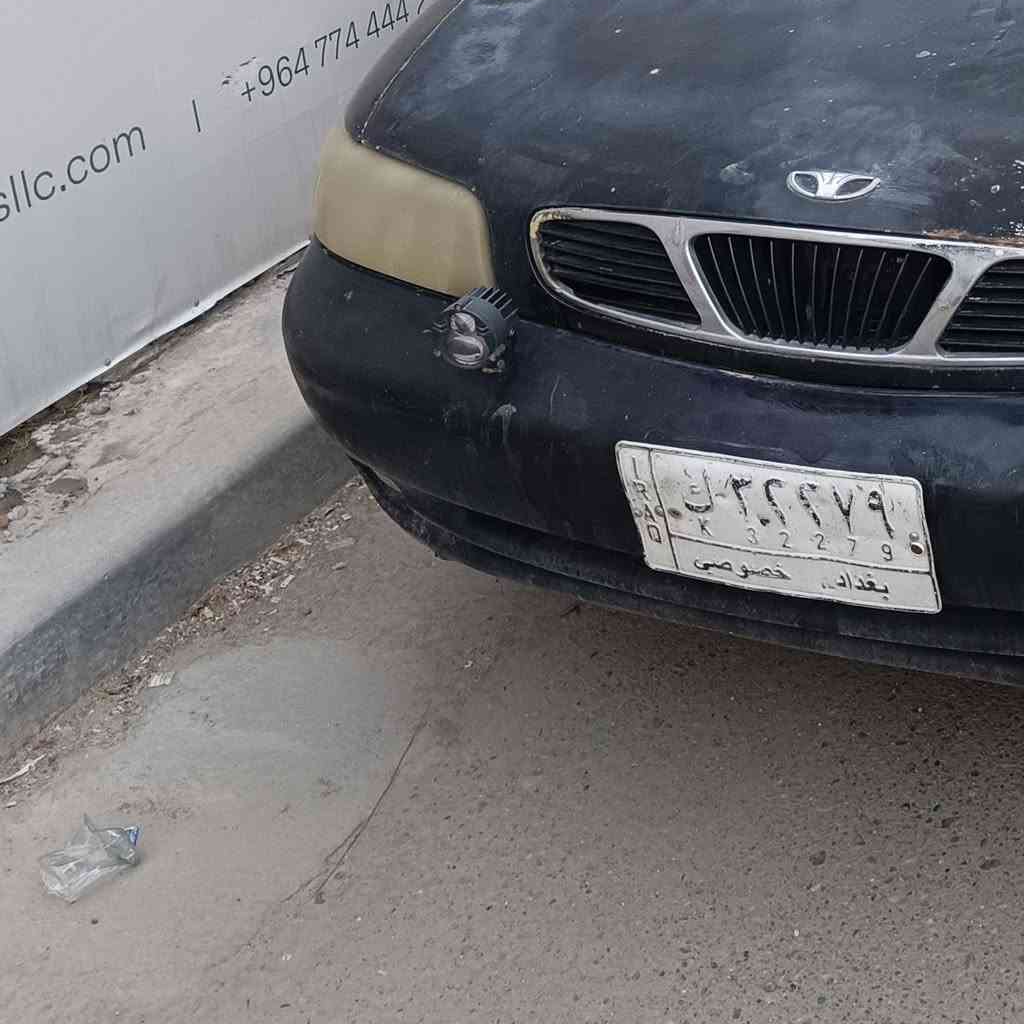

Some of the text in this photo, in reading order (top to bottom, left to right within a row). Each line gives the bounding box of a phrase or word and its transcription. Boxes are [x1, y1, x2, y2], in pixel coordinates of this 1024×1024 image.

[241, 47, 310, 102] +964
[314, 21, 360, 67] 774
[694, 558, 889, 601] بغداد خصوصي
